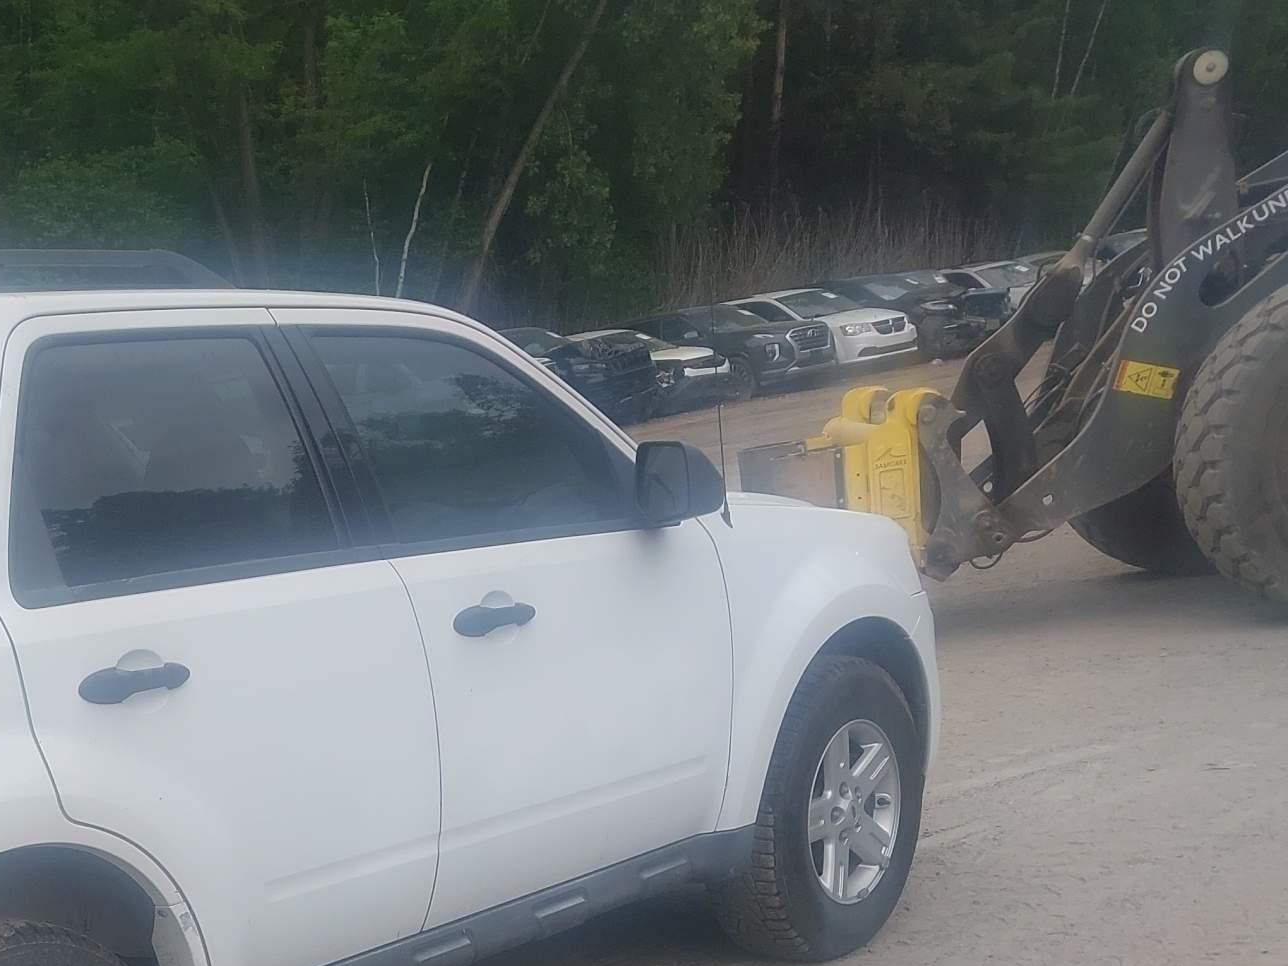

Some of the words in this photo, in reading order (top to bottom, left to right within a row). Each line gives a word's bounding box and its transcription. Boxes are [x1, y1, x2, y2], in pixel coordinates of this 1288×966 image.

[1130, 302, 1158, 333] DO
[1153, 256, 1188, 300] NOT
[1190, 215, 1255, 262] WALK
